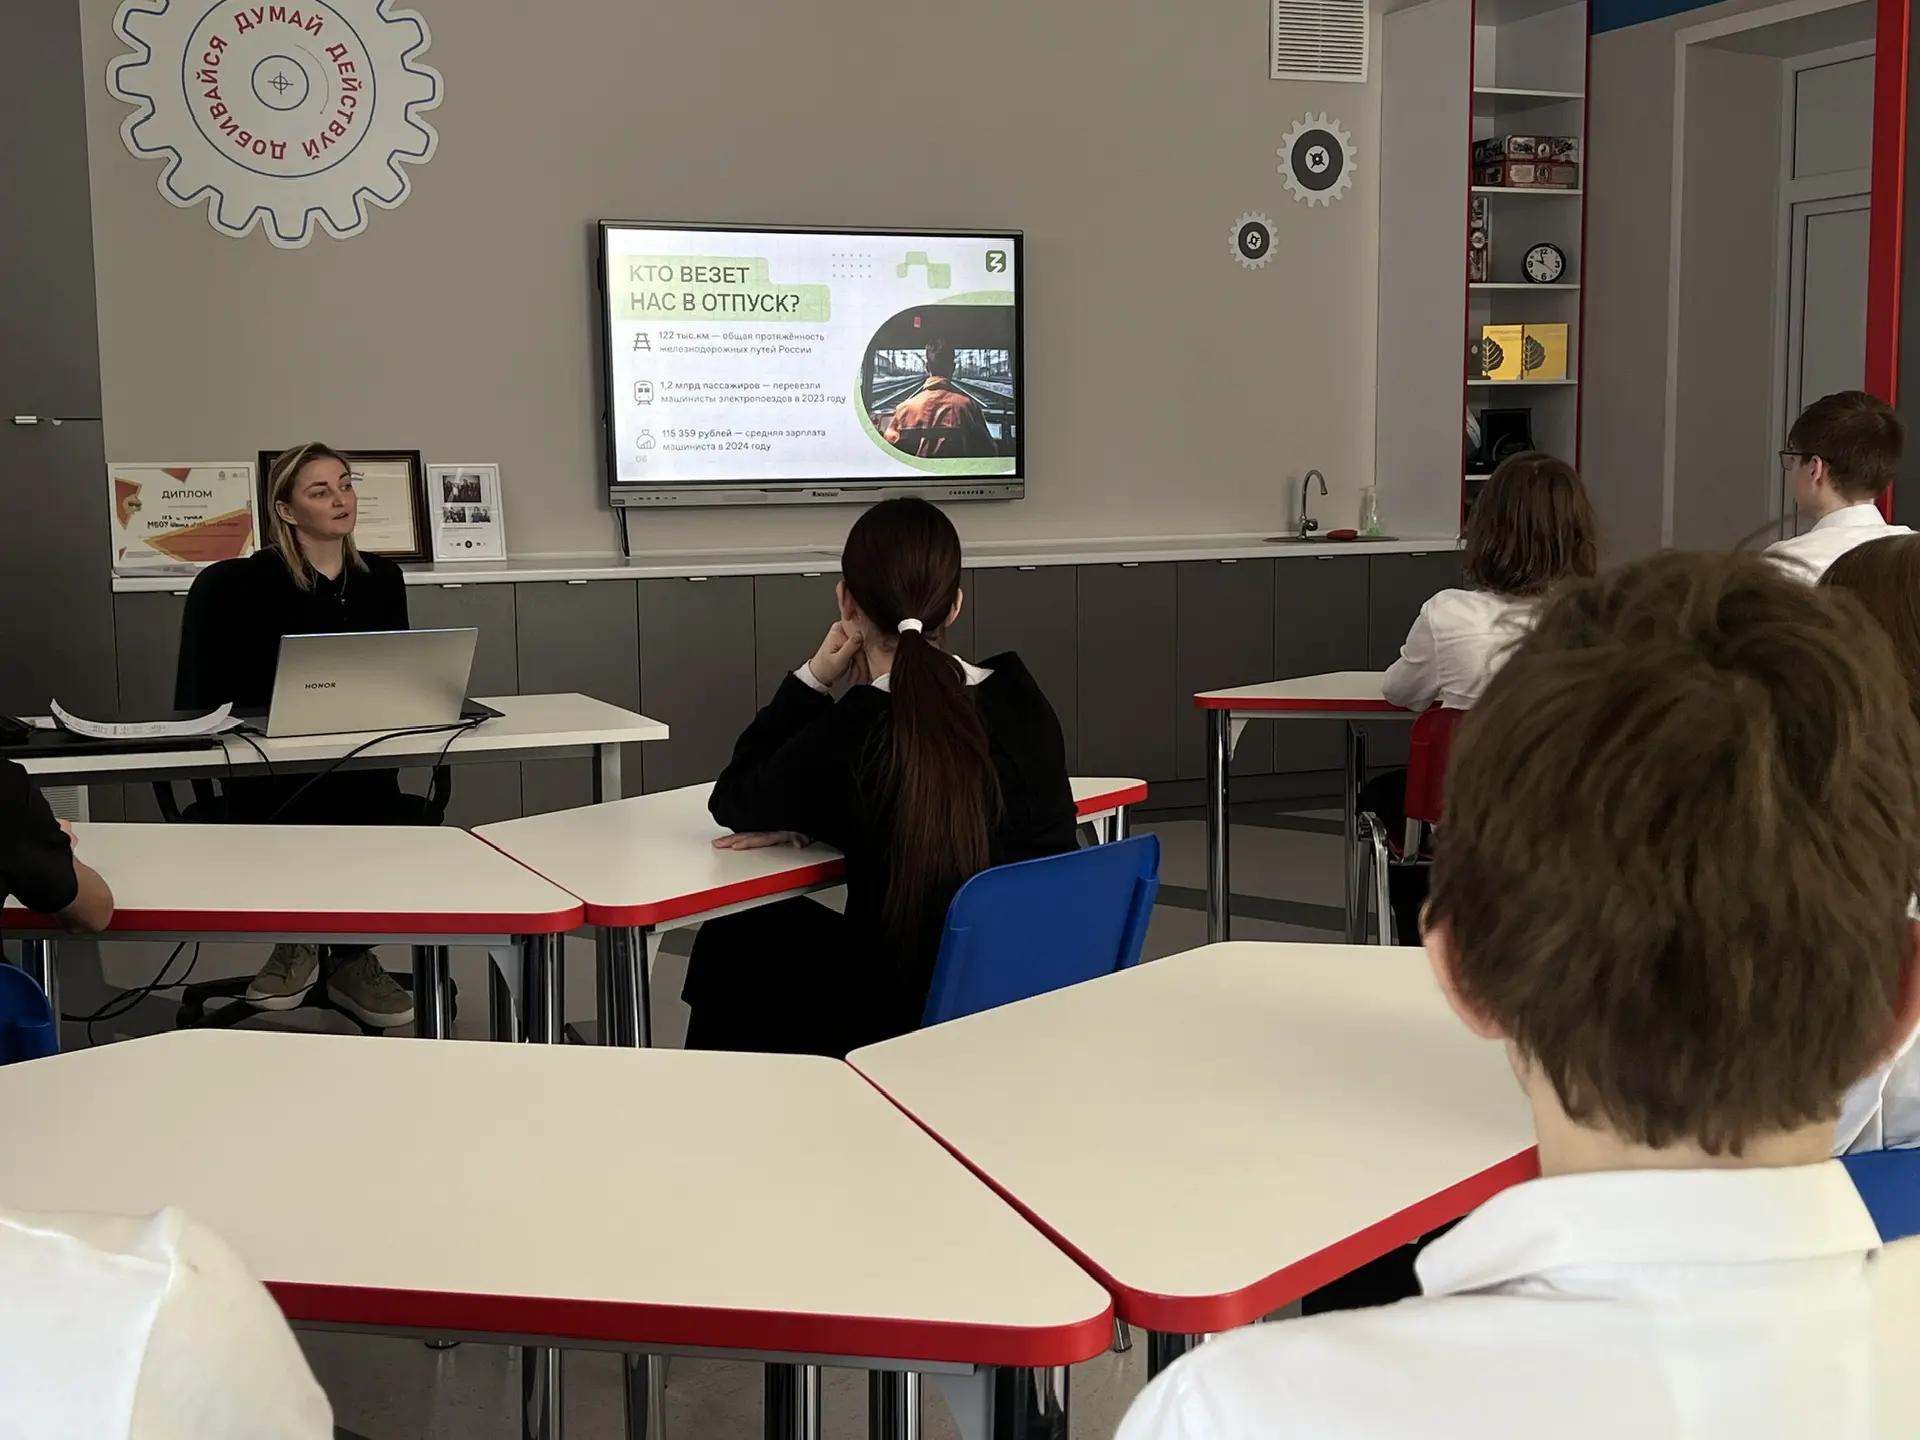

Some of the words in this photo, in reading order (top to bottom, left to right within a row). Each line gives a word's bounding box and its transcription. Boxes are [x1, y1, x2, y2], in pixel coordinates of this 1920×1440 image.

[234, 5, 324, 37] ДУМАЙ
[196, 35, 287, 160] ДОБИВАЙСЯ
[302, 42, 363, 161] ДЕЙСТВУЙ
[629, 265, 673, 282] КТО
[680, 266, 750, 283] ВЕЗЕТ
[631, 292, 676, 311] НАС
[683, 293, 696, 311] В
[702, 293, 800, 312] ОТПУСК?
[658, 331, 675, 340] 122
[722, 332, 753, 341] общая
[755, 332, 825, 342] протяжённость
[659, 345, 748, 355] железнодорожных
[750, 345, 776, 355] путей
[779, 346, 812, 354] России
[660, 382, 673, 391] 1,2
[675, 382, 701, 391] млрд
[703, 382, 760, 391] пассажиров
[773, 382, 821, 391] перевезли
[661, 395, 716, 403] машинисты
[718, 395, 793, 404] электропоездов
[794, 395, 800, 403] в
[802, 394, 825, 403] 2023
[826, 395, 846, 404] году
[662, 429, 676, 437] 115
[678, 429, 696, 438] 359
[698, 429, 732, 439] рублей
[745, 430, 784, 438] средняя
[785, 430, 826, 439] зарплата
[663, 443, 716, 451] машиниста
[725, 442, 749, 451] 2024
[751, 443, 771, 452] году
[161, 490, 213, 500] ДИПЛОМ
